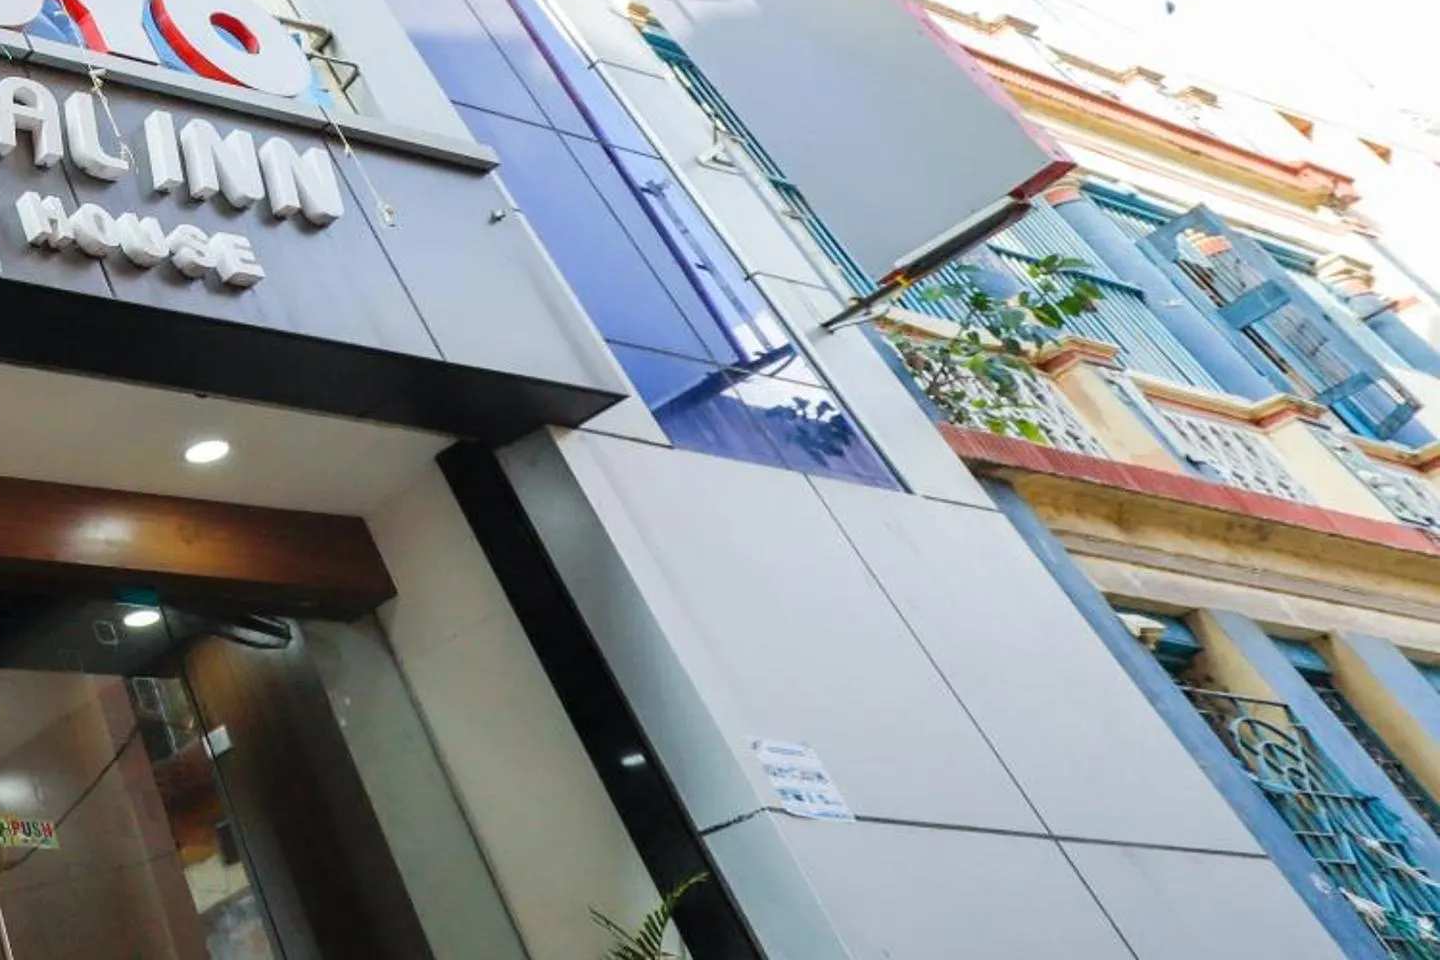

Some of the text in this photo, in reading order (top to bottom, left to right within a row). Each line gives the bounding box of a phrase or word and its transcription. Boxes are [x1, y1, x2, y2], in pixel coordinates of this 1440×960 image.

[144, 109, 345, 228] INN
[15, 190, 266, 289] HOUSE
[11, 818, 53, 839] PUSH
